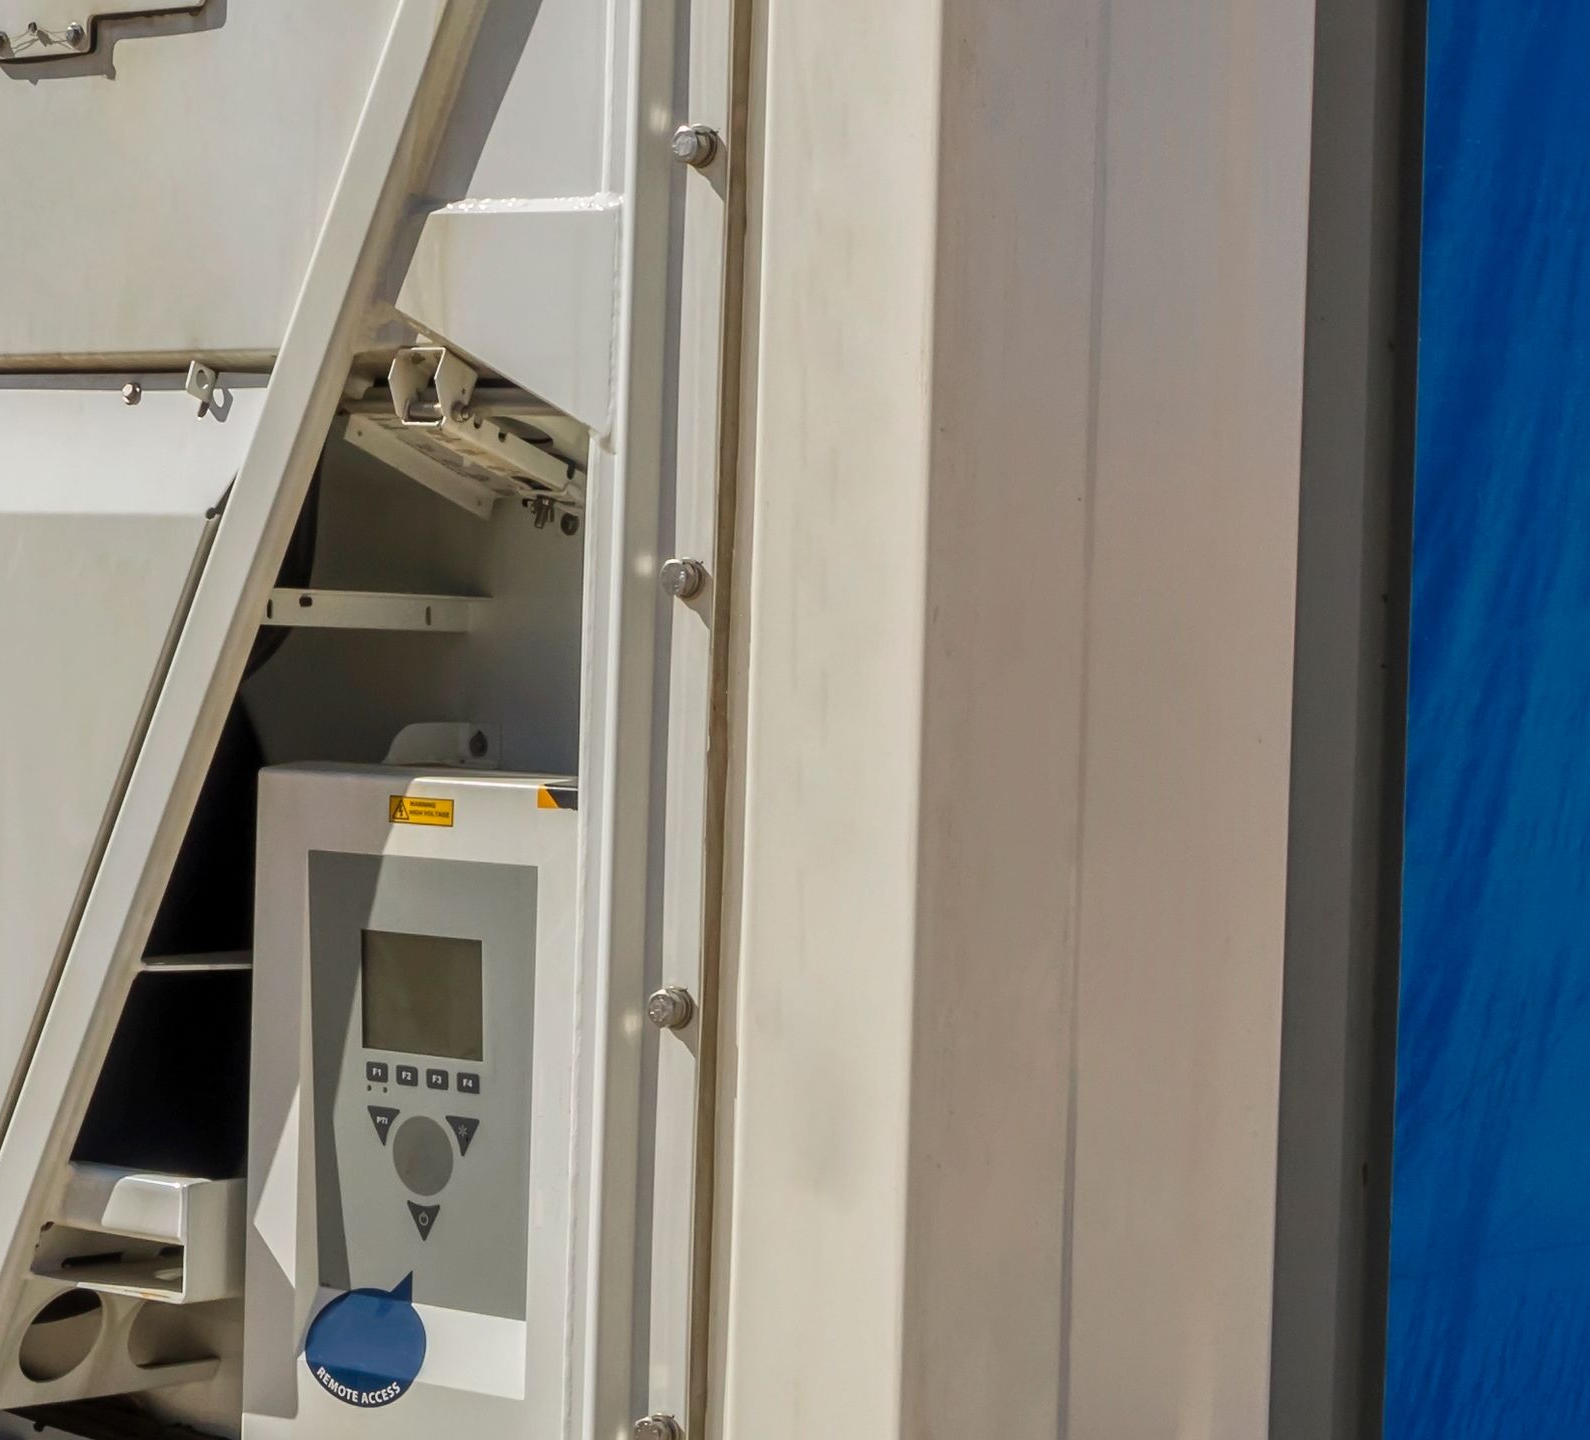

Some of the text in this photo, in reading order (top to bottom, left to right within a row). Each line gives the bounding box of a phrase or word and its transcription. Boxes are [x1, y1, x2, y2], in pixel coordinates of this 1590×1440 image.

[372, 1067, 473, 1088] F1 F2 F3 F4
[316, 1366, 401, 1404] REMOTE ACCESS
